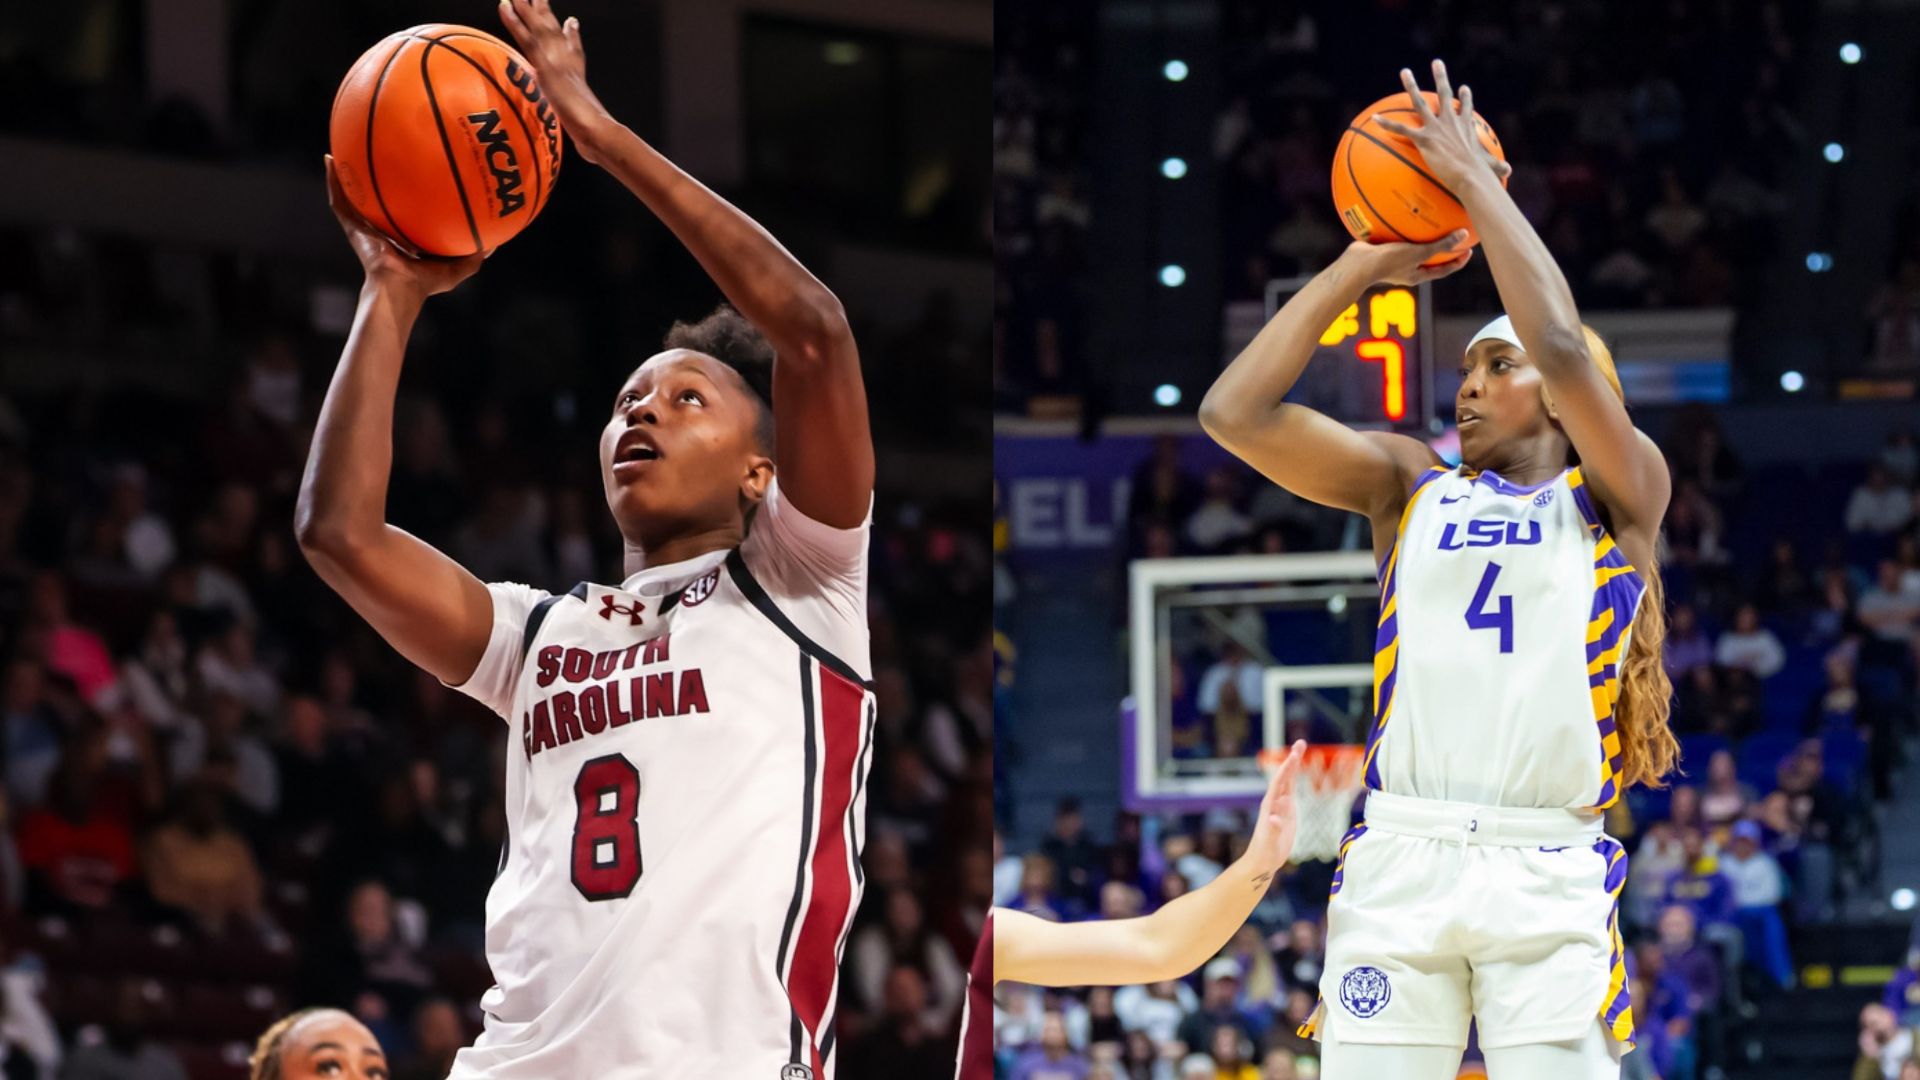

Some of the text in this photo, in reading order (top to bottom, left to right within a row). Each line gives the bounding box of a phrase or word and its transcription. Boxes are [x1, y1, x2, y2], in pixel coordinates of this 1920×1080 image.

[467, 109, 526, 219] NCAA
[1355, 339, 1406, 421] 7
[1534, 489, 1552, 505] SEC
[1437, 519, 1542, 551] LSU
[683, 574, 716, 603] SEC
[1464, 560, 1514, 653] 4
[536, 633, 671, 688] SOUTH
[570, 752, 643, 902] 8
